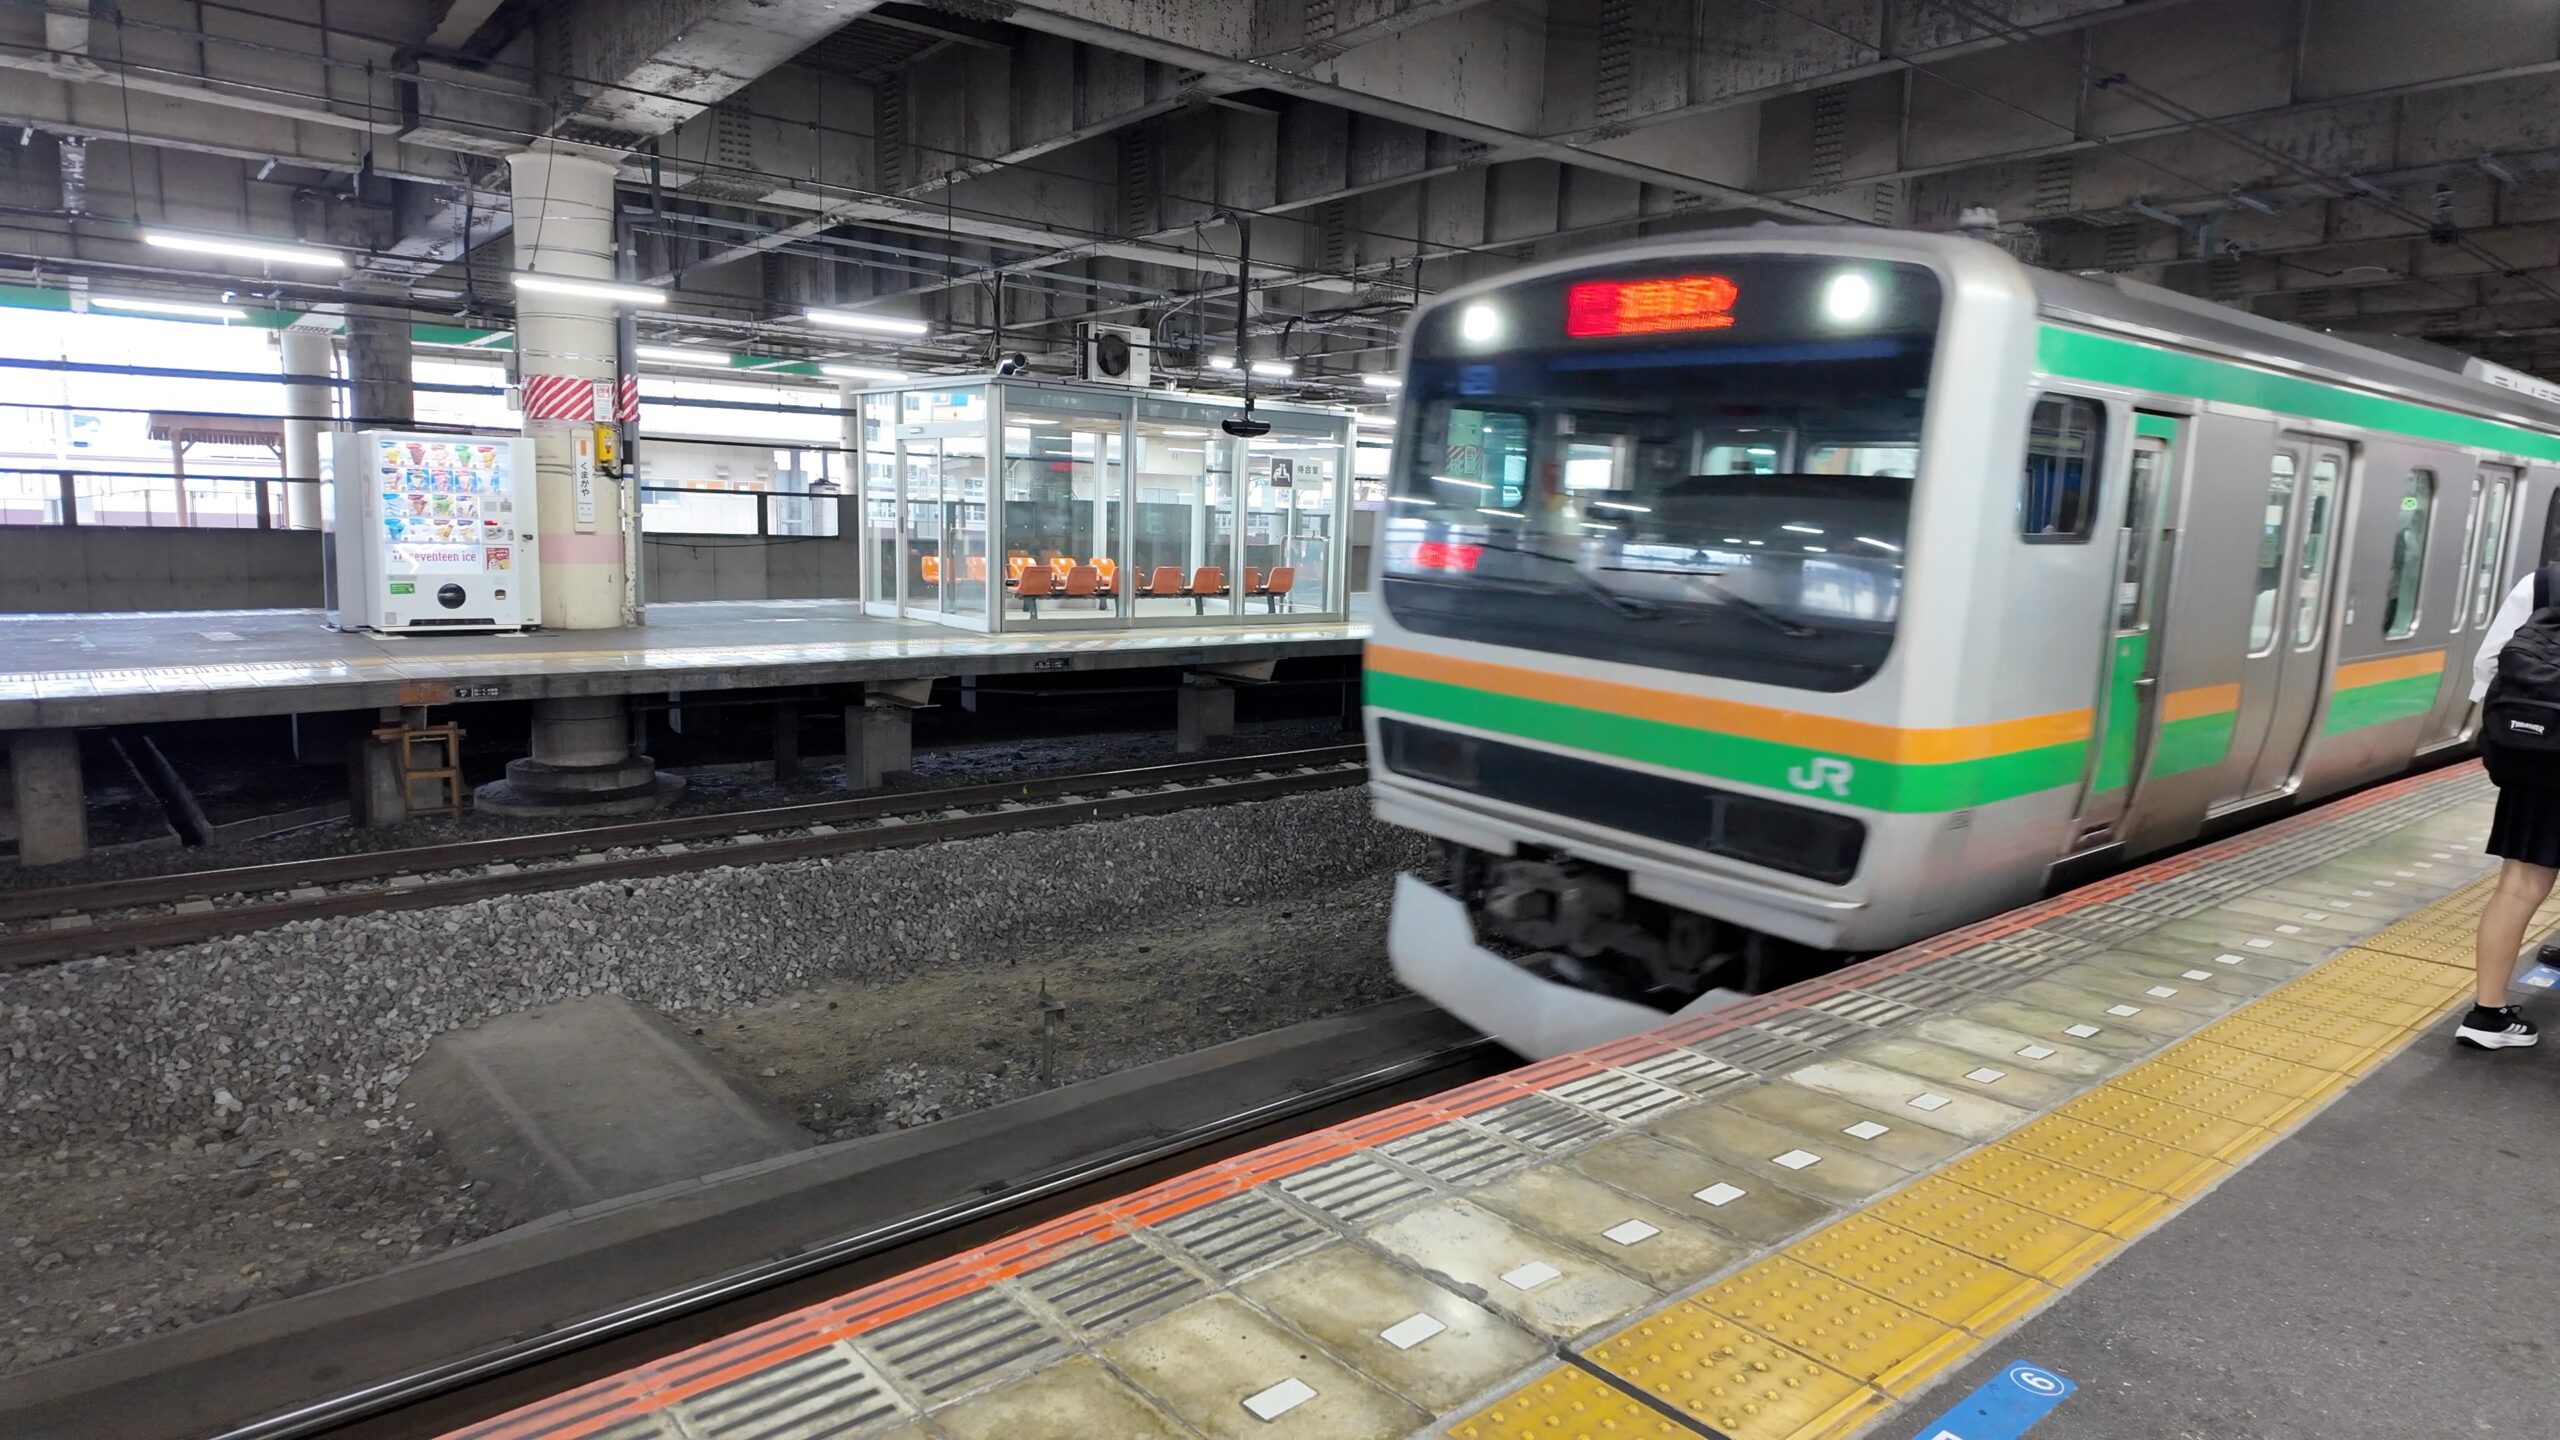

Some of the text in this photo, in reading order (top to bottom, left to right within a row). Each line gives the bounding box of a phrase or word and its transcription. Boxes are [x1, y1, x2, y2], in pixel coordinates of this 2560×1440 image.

[580, 462, 590, 497] くまがや
[462, 550, 477, 562] ice
[1787, 757, 1854, 796] JR
